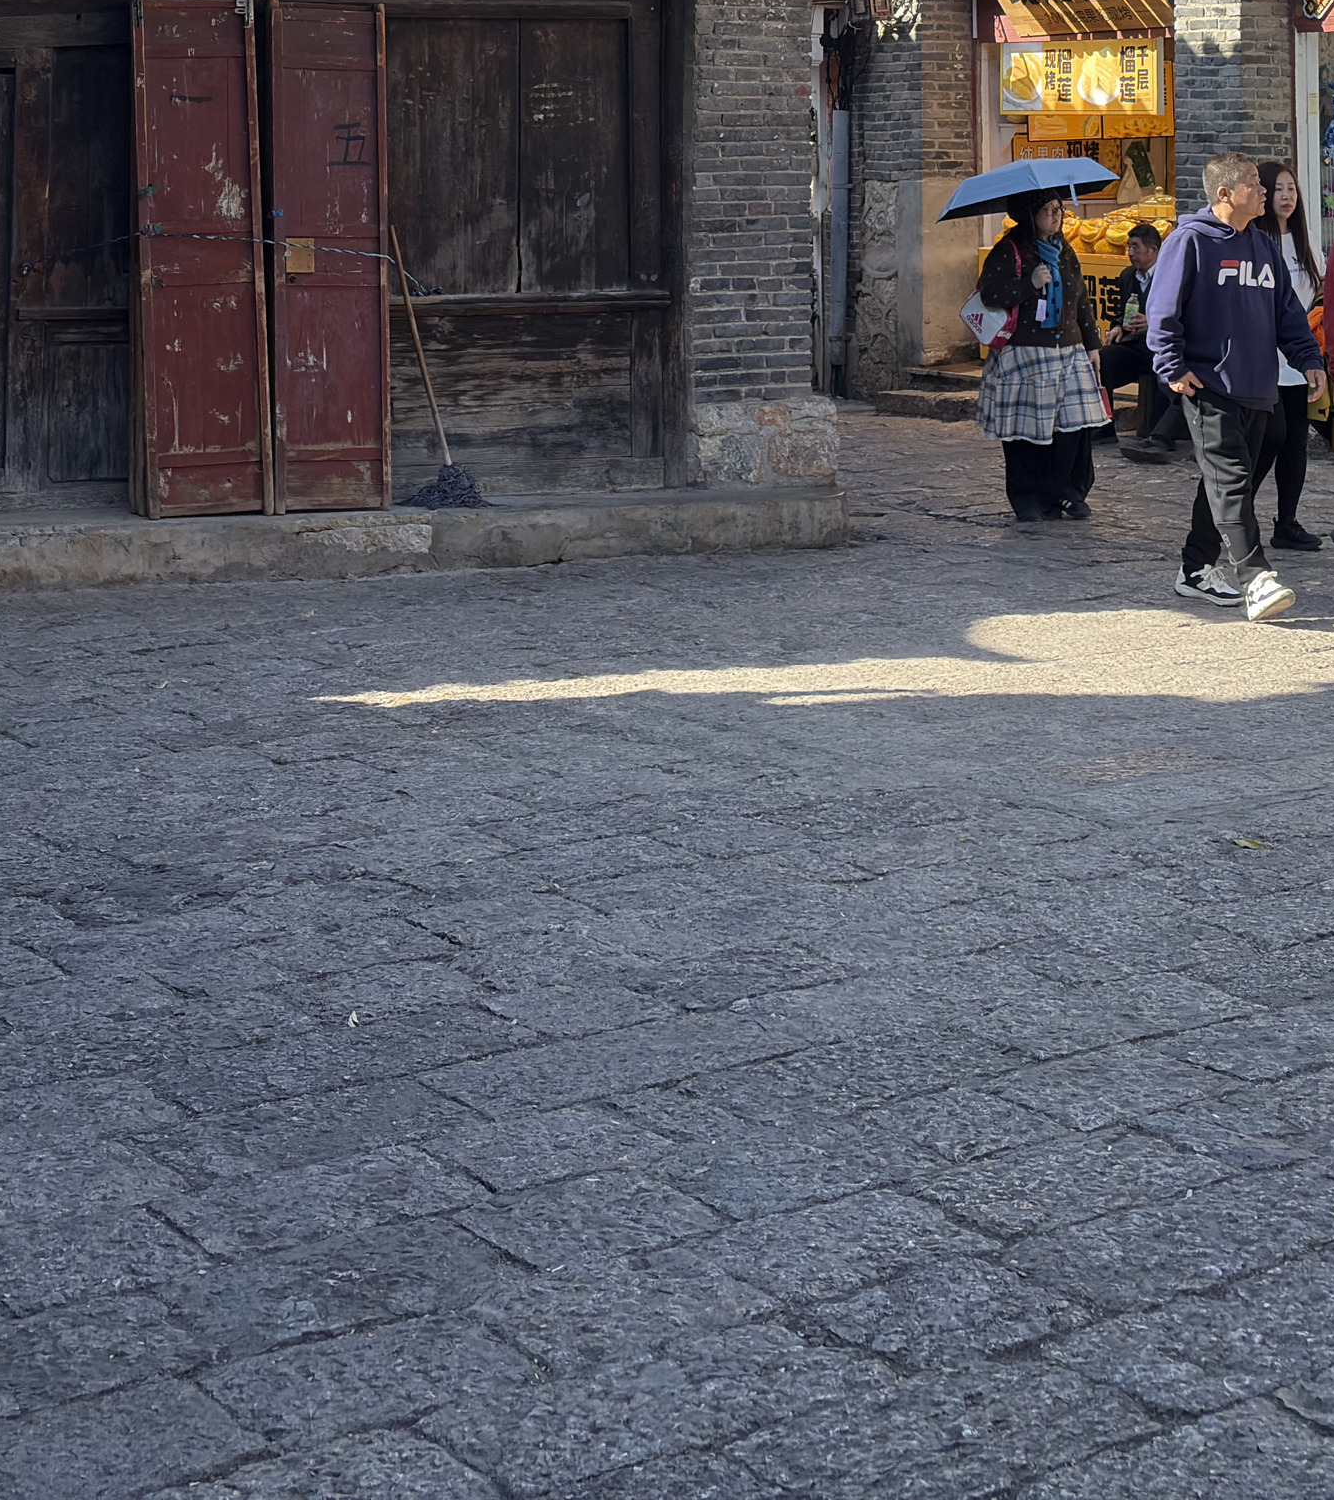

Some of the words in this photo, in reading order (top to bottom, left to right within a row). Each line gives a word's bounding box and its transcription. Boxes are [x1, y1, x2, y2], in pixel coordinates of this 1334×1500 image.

[1045, 49, 1056, 90] 现烤
[1057, 49, 1071, 102] 榴莲
[1120, 46, 1135, 102] 榴莲
[1137, 45, 1149, 90] 千层
[1218, 260, 1275, 289] FILA
